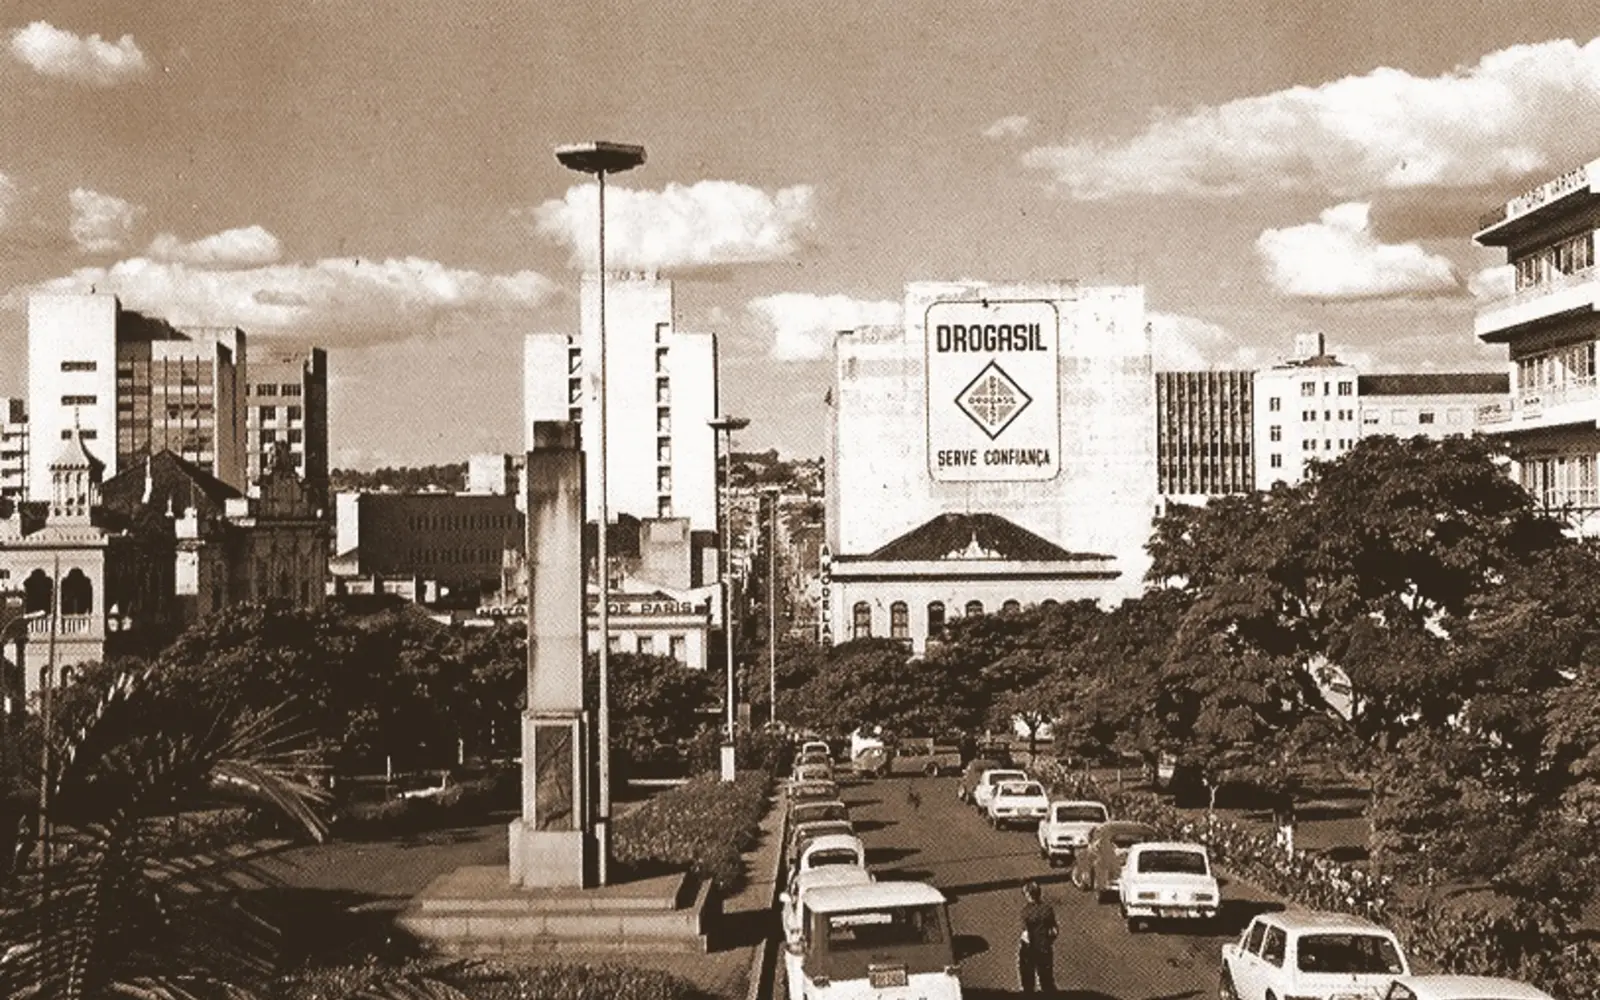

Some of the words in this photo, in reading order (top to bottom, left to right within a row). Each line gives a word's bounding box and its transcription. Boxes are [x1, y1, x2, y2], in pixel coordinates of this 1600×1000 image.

[936, 322, 1048, 352] DROGASIL
[938, 449, 977, 467] SERVE
[984, 448, 1051, 468] CONFIANÇA
[608, 602, 632, 616] DE
[641, 601, 692, 616] PARIS
